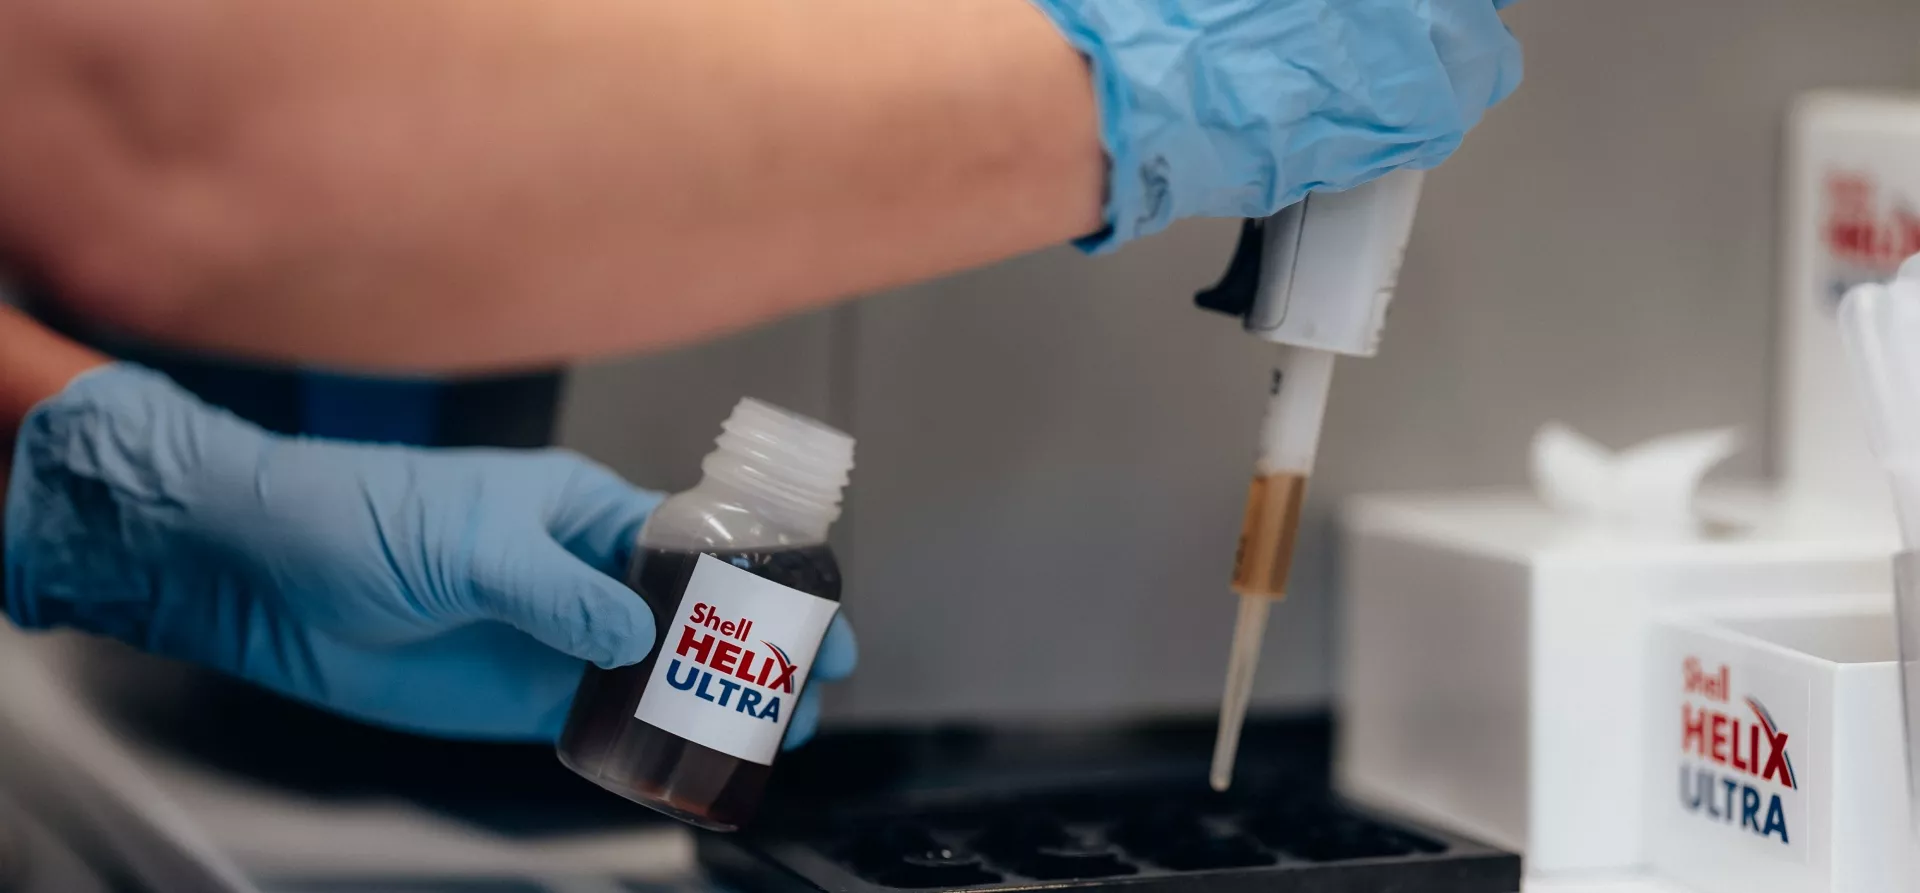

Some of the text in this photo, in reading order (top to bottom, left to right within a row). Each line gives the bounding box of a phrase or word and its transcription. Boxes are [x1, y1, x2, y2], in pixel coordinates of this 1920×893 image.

[689, 602, 753, 642] Shell
[666, 658, 780, 723] ULTRA
[676, 624, 798, 694] HELIX
[1681, 696, 1795, 789] HELIX
[1679, 763, 1789, 844] ULTRA
